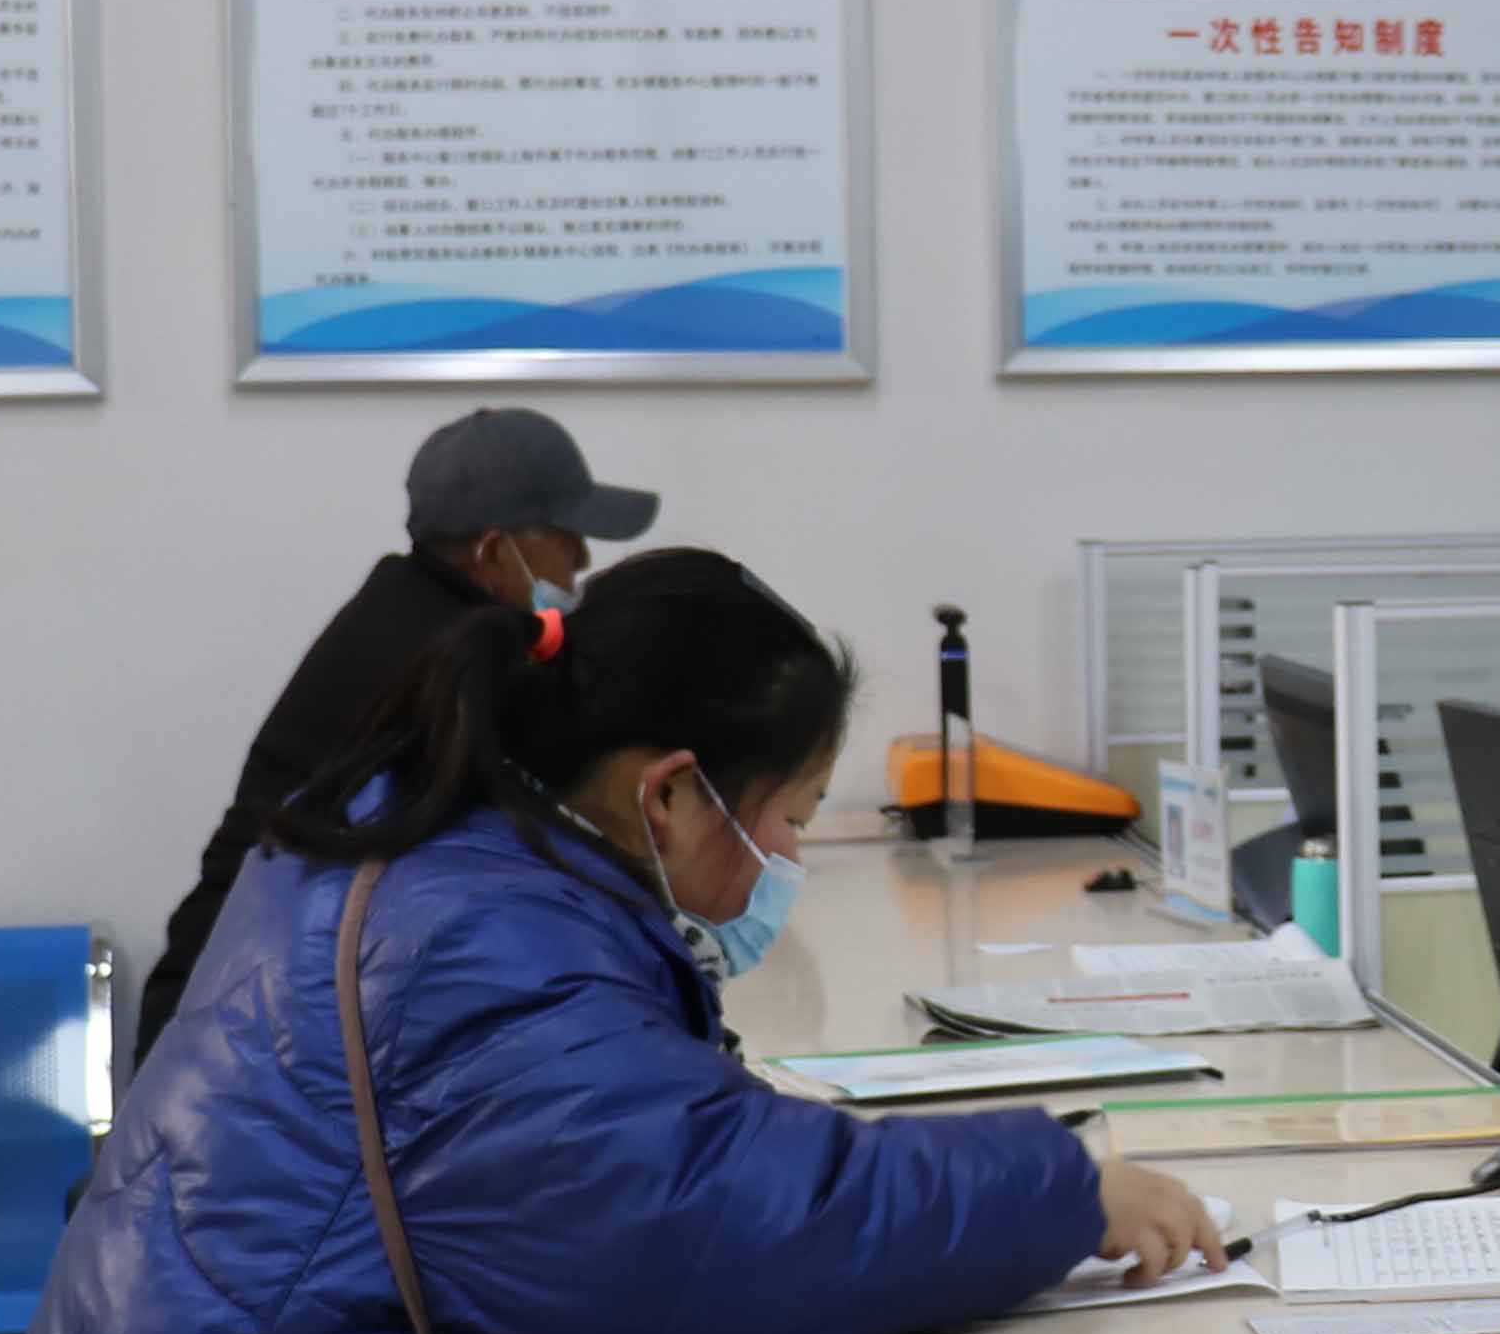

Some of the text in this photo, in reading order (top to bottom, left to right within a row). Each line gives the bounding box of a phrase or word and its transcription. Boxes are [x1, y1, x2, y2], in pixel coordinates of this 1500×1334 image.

[1171, 17, 1445, 56] 一次性告知制度
